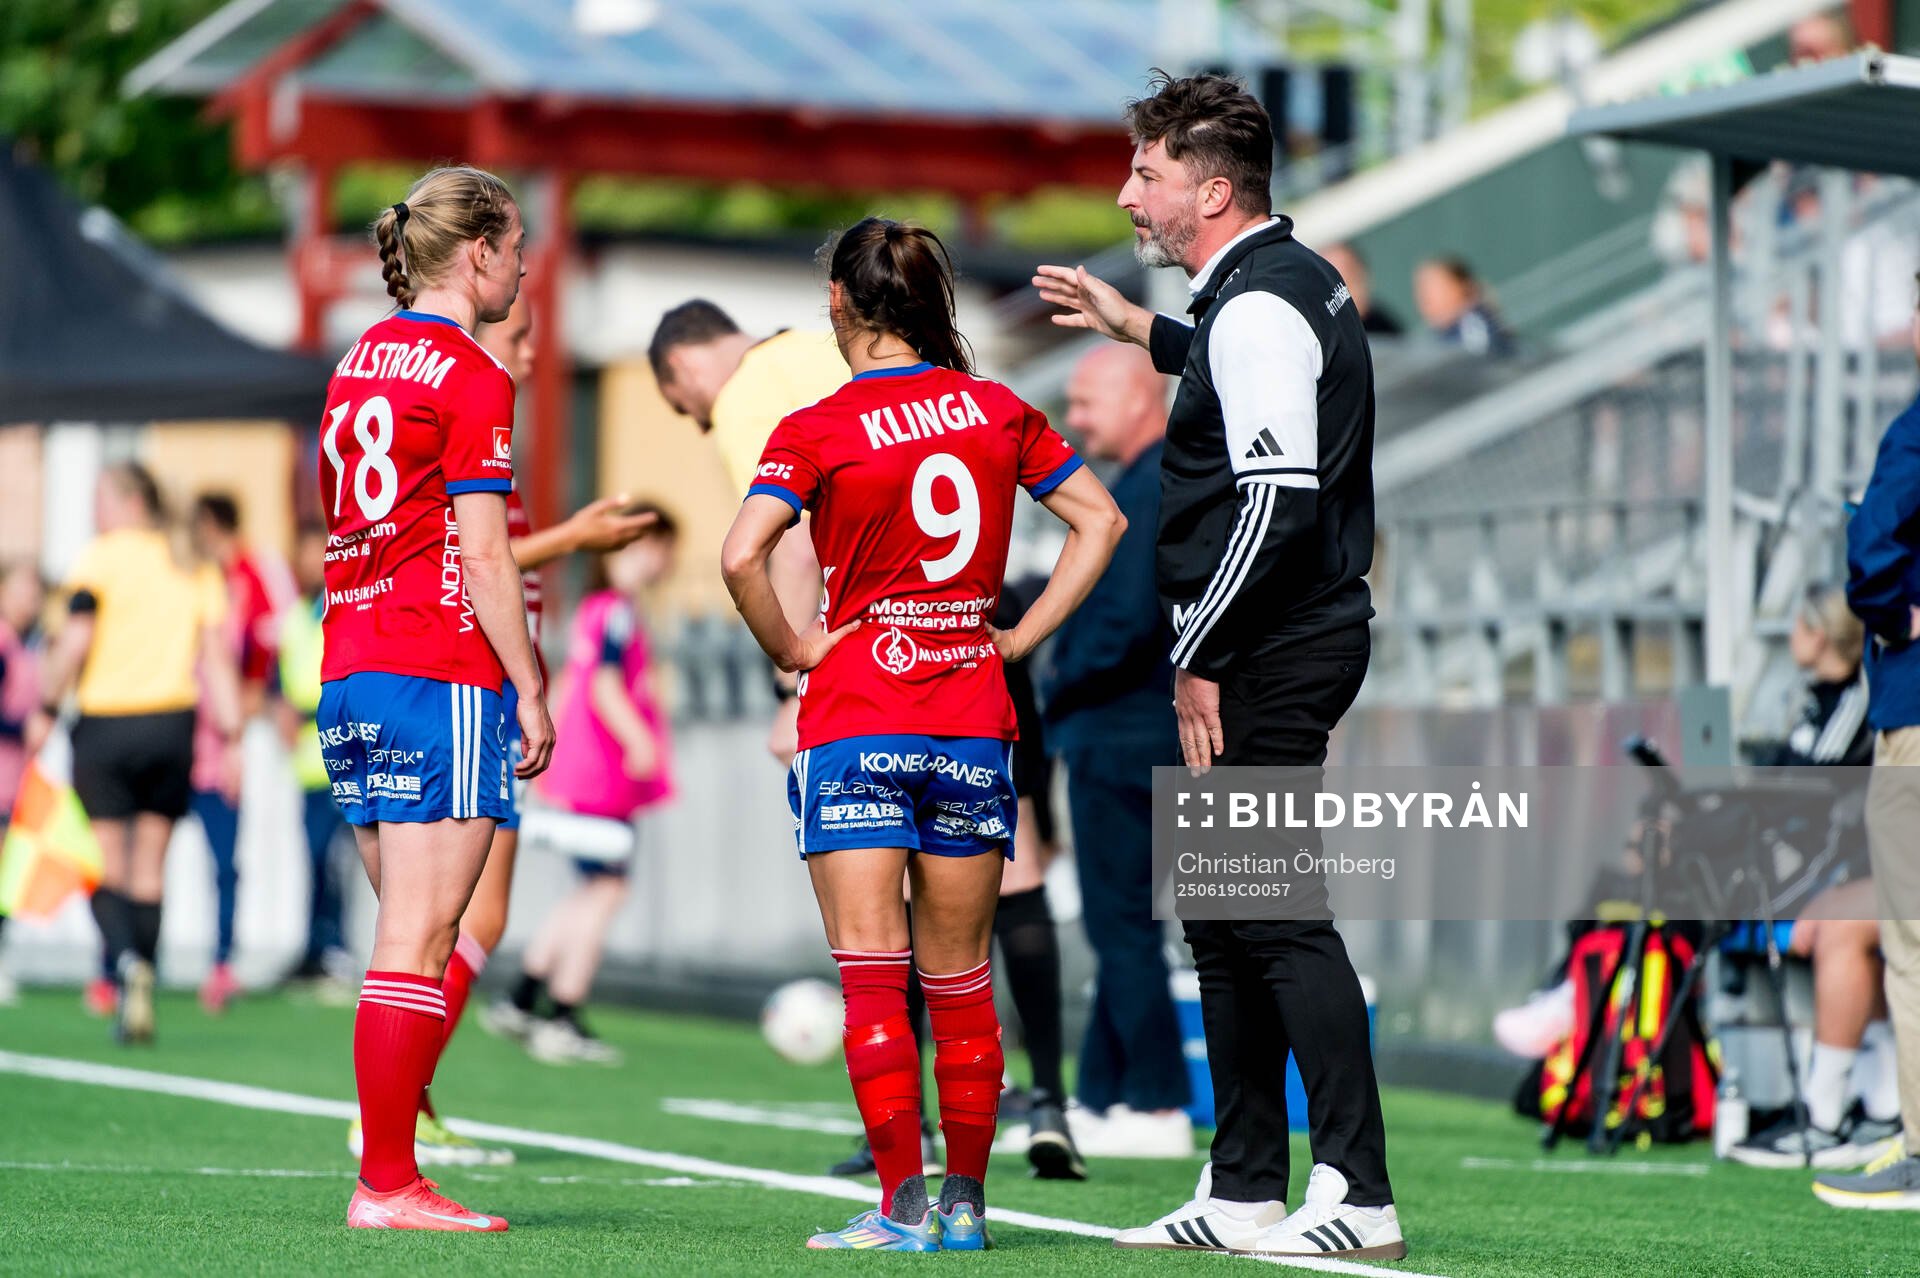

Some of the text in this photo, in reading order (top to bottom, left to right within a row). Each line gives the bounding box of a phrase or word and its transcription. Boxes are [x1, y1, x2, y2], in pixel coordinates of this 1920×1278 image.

[859, 391, 988, 450] KLINGA
[323, 396, 398, 521] 18
[911, 452, 980, 582] 9
[961, 614, 981, 627] AB
[832, 803, 896, 821] PEAB
